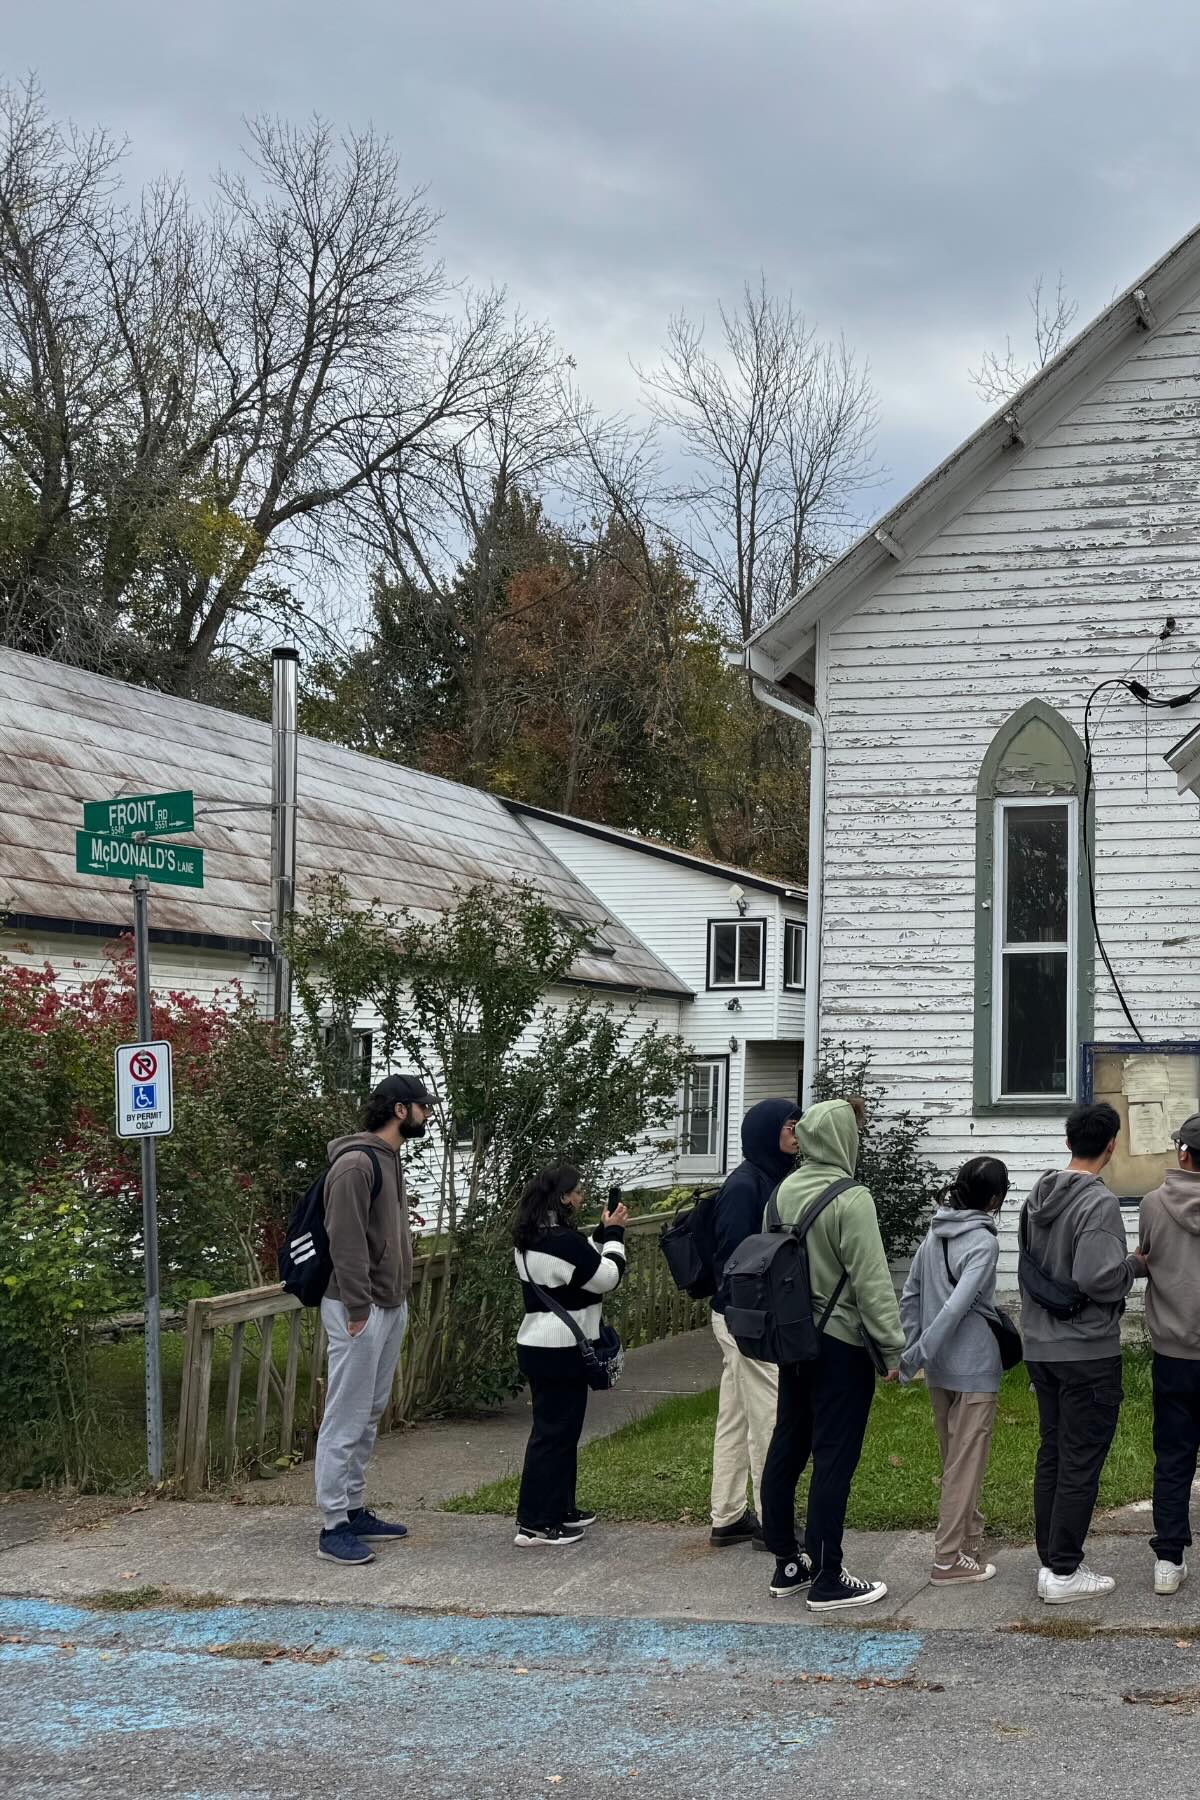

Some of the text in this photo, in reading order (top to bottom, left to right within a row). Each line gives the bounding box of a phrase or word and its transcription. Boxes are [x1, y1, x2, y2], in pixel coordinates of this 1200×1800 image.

[109, 800, 168, 826] FRONT RD
[111, 825, 124, 835] 5549
[91, 838, 194, 873] McDONALD'S LANE
[137, 1111, 162, 1120] PERMIT
